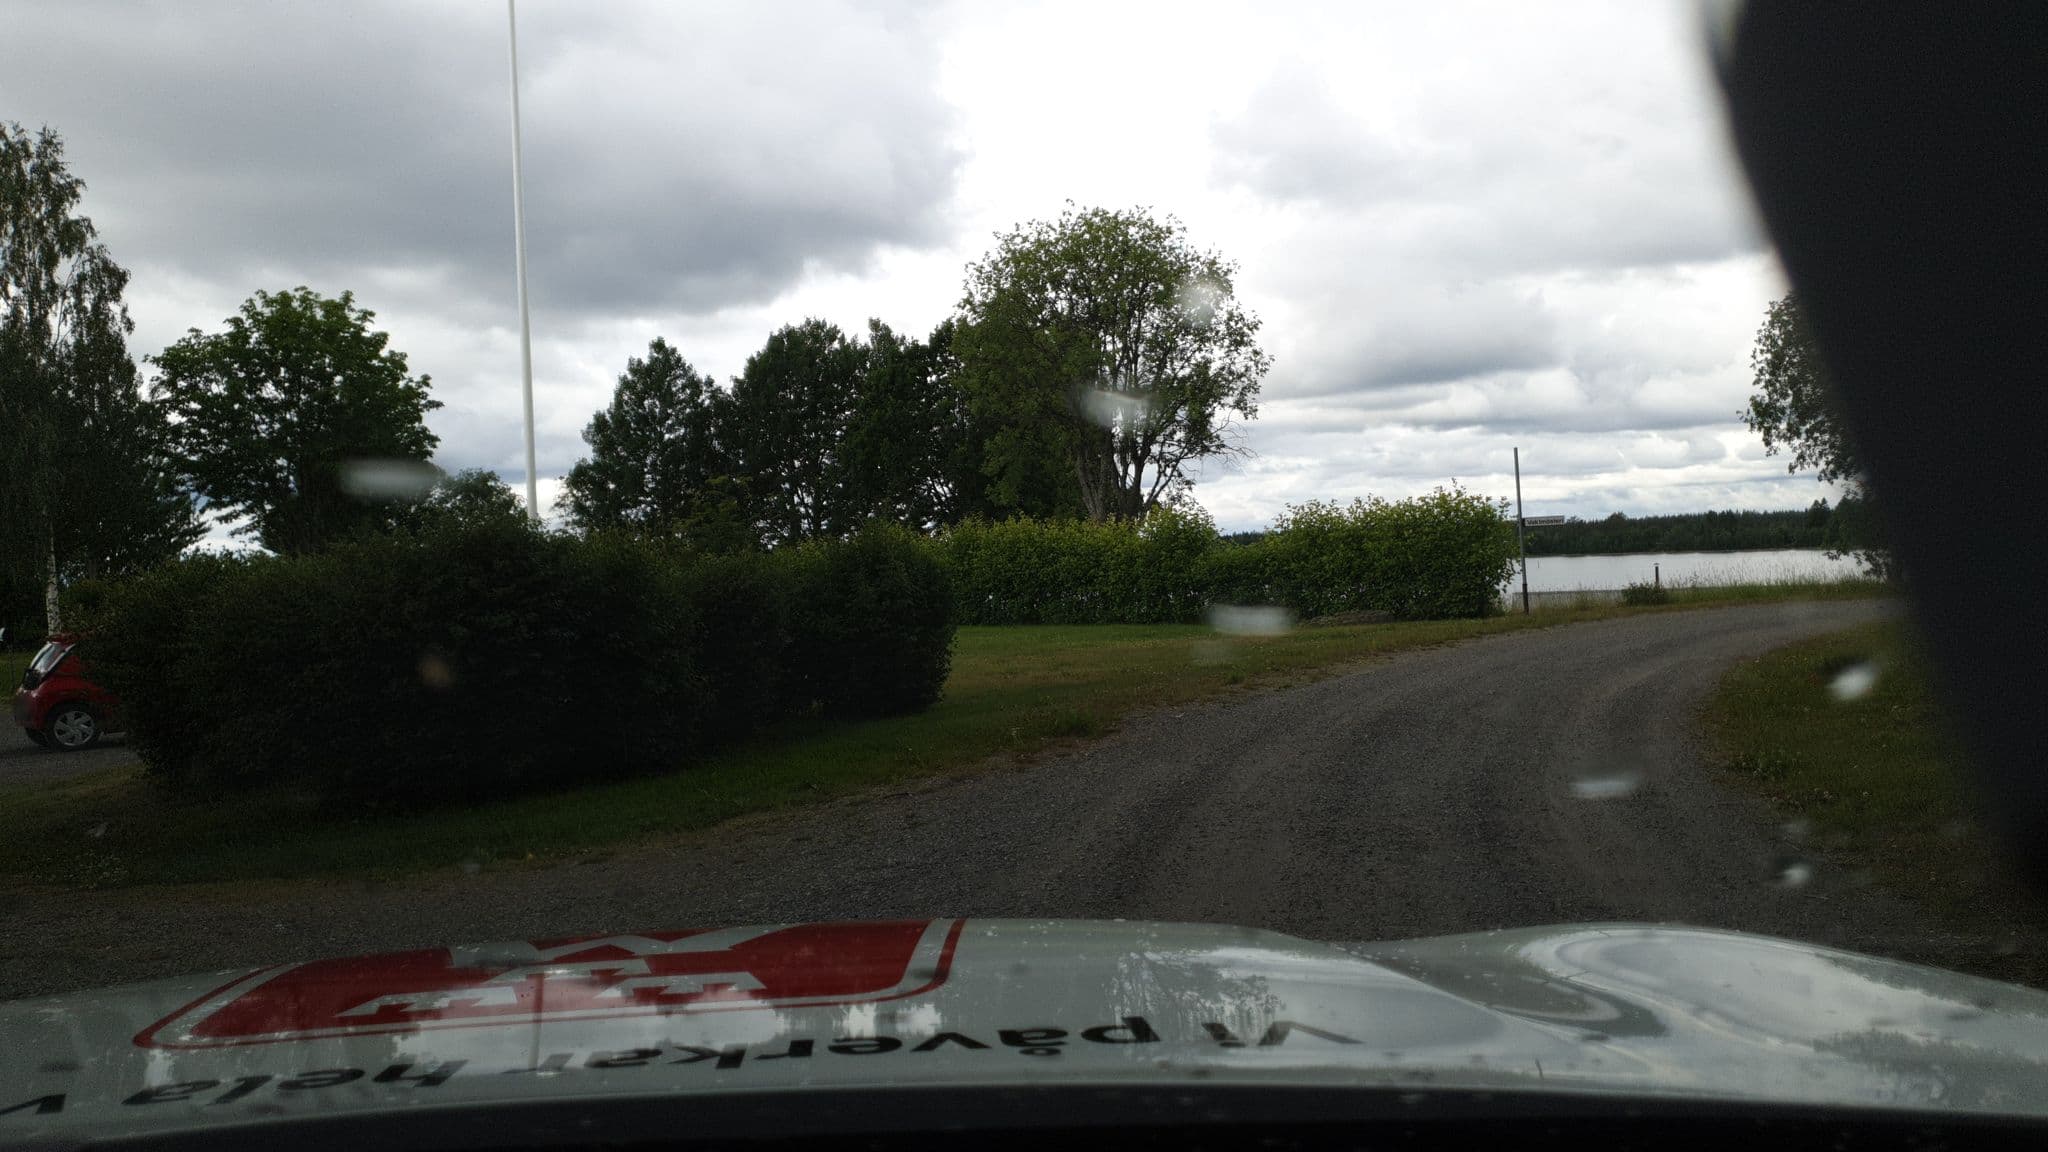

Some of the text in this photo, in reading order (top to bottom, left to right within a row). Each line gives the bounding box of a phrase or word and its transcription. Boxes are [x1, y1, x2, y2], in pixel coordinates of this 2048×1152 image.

[503, 1016, 1161, 1073] påverkar
[1202, 1020, 1365, 1048] Vi
[121, 1059, 469, 1105] hela
